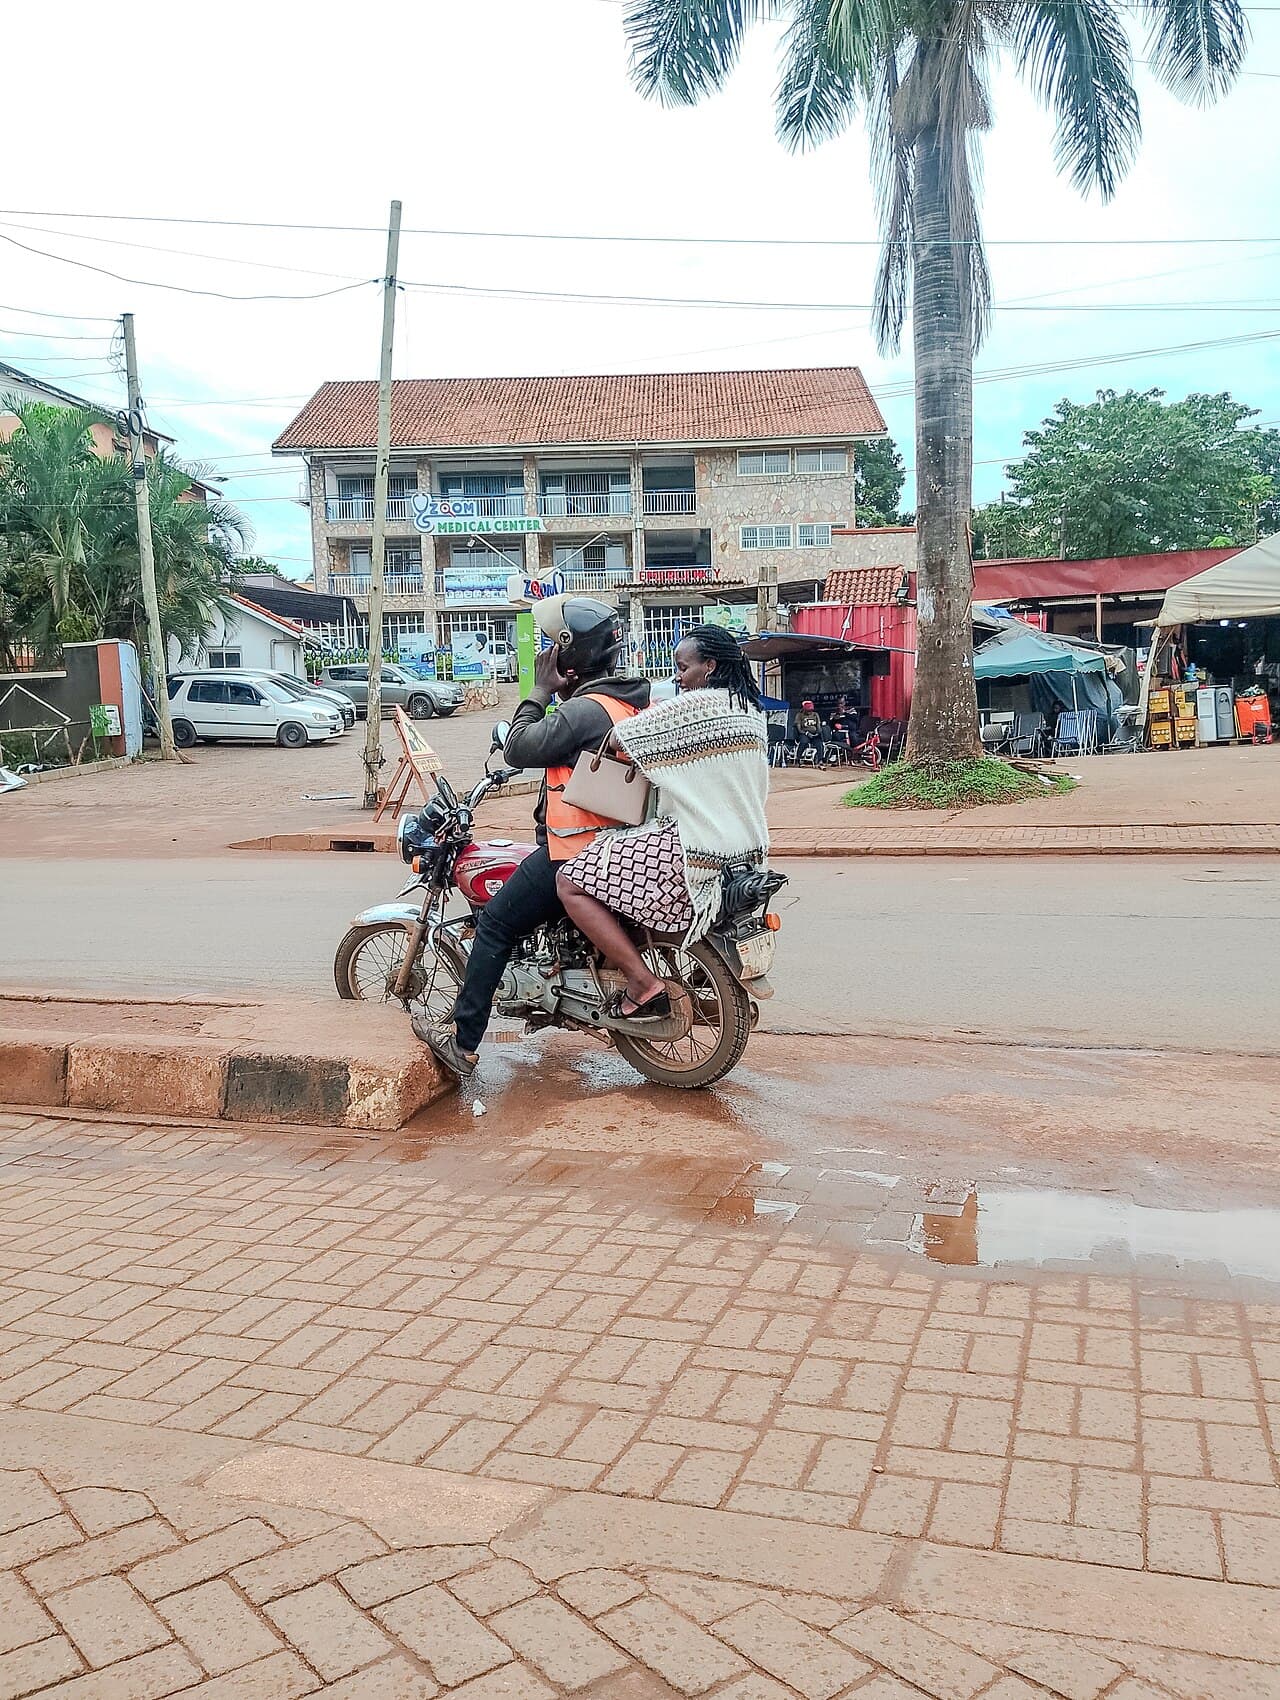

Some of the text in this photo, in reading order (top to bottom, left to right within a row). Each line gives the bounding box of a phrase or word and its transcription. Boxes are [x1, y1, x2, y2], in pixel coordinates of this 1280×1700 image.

[429, 502, 474, 516] ZOOM
[437, 519, 541, 533] MEDICAL CENTER
